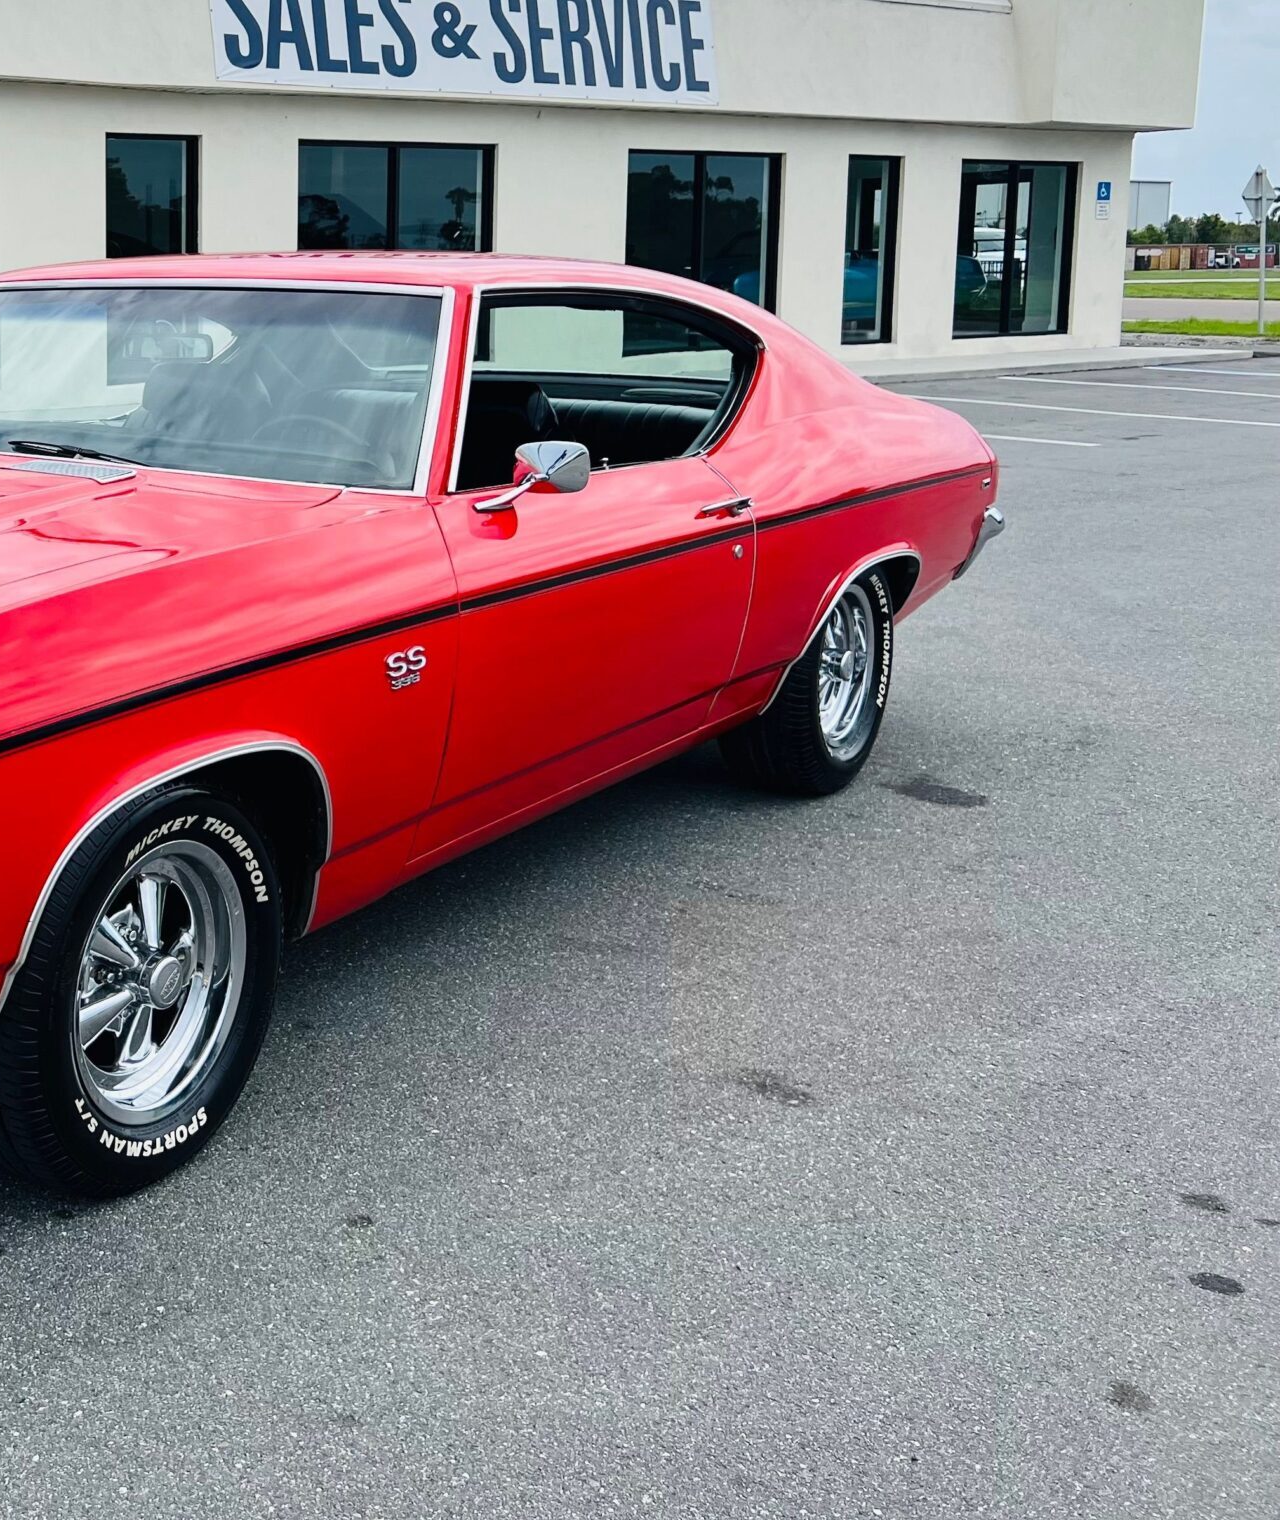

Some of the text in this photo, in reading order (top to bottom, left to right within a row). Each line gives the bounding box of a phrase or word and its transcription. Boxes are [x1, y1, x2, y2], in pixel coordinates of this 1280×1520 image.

[224, 0, 710, 92] SALES & SERVICE
[869, 573, 889, 615] MICKEY
[384, 645, 426, 677] SS
[876, 620, 891, 708] THOMPSON
[124, 815, 269, 902] MICKEY THOMPSON
[75, 1098, 207, 1157] SPORTSMAN S/T
